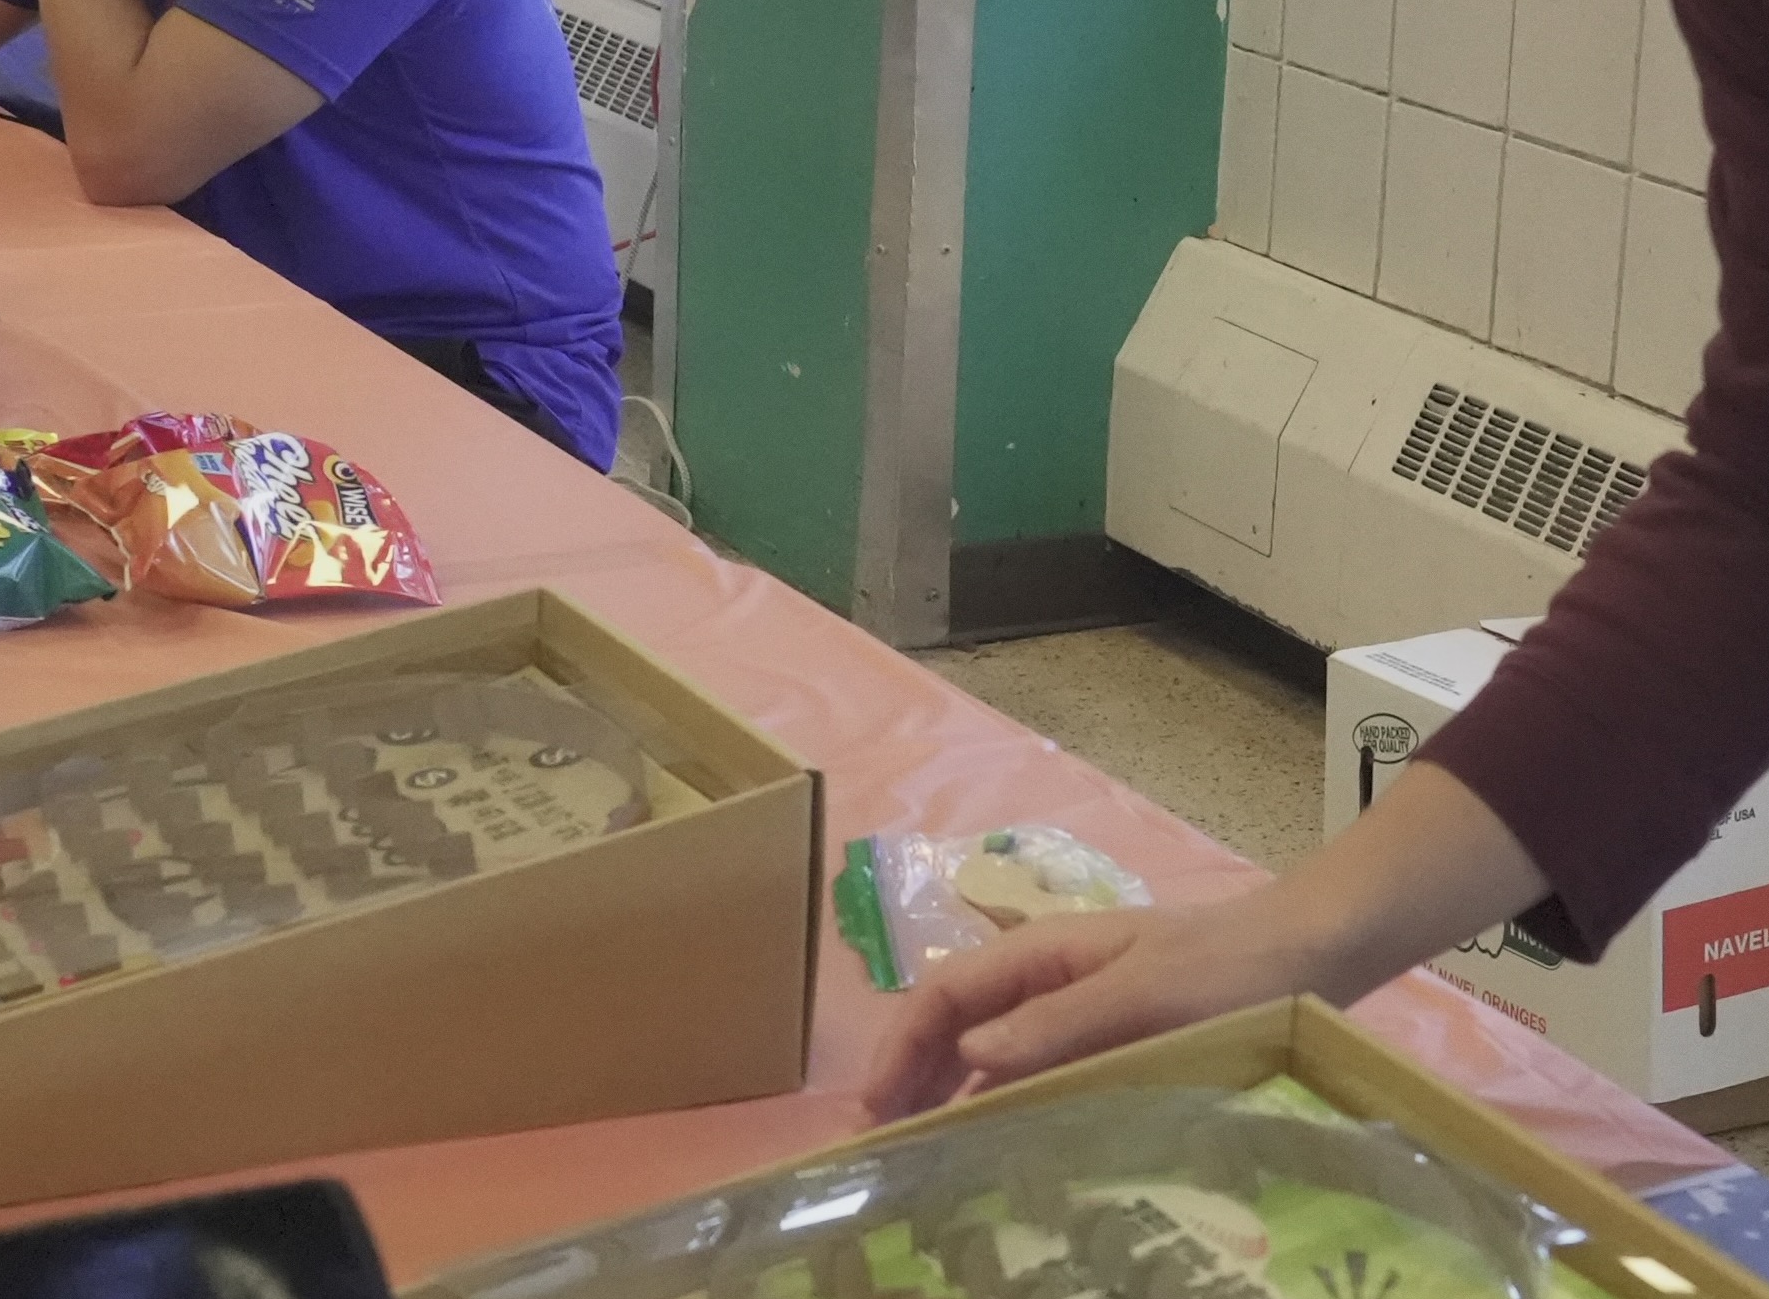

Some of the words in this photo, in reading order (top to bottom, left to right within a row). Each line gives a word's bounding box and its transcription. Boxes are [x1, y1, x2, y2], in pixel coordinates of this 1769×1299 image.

[338, 483, 371, 527] WISE
[1359, 725, 1380, 739] HAND
[1381, 726, 1411, 740] PACKED
[1379, 740, 1409, 753] QUALITY
[1734, 808, 1756, 822] USA
[1438, 967, 1476, 997] NAVEL
[1481, 990, 1547, 1035] ORANGES
